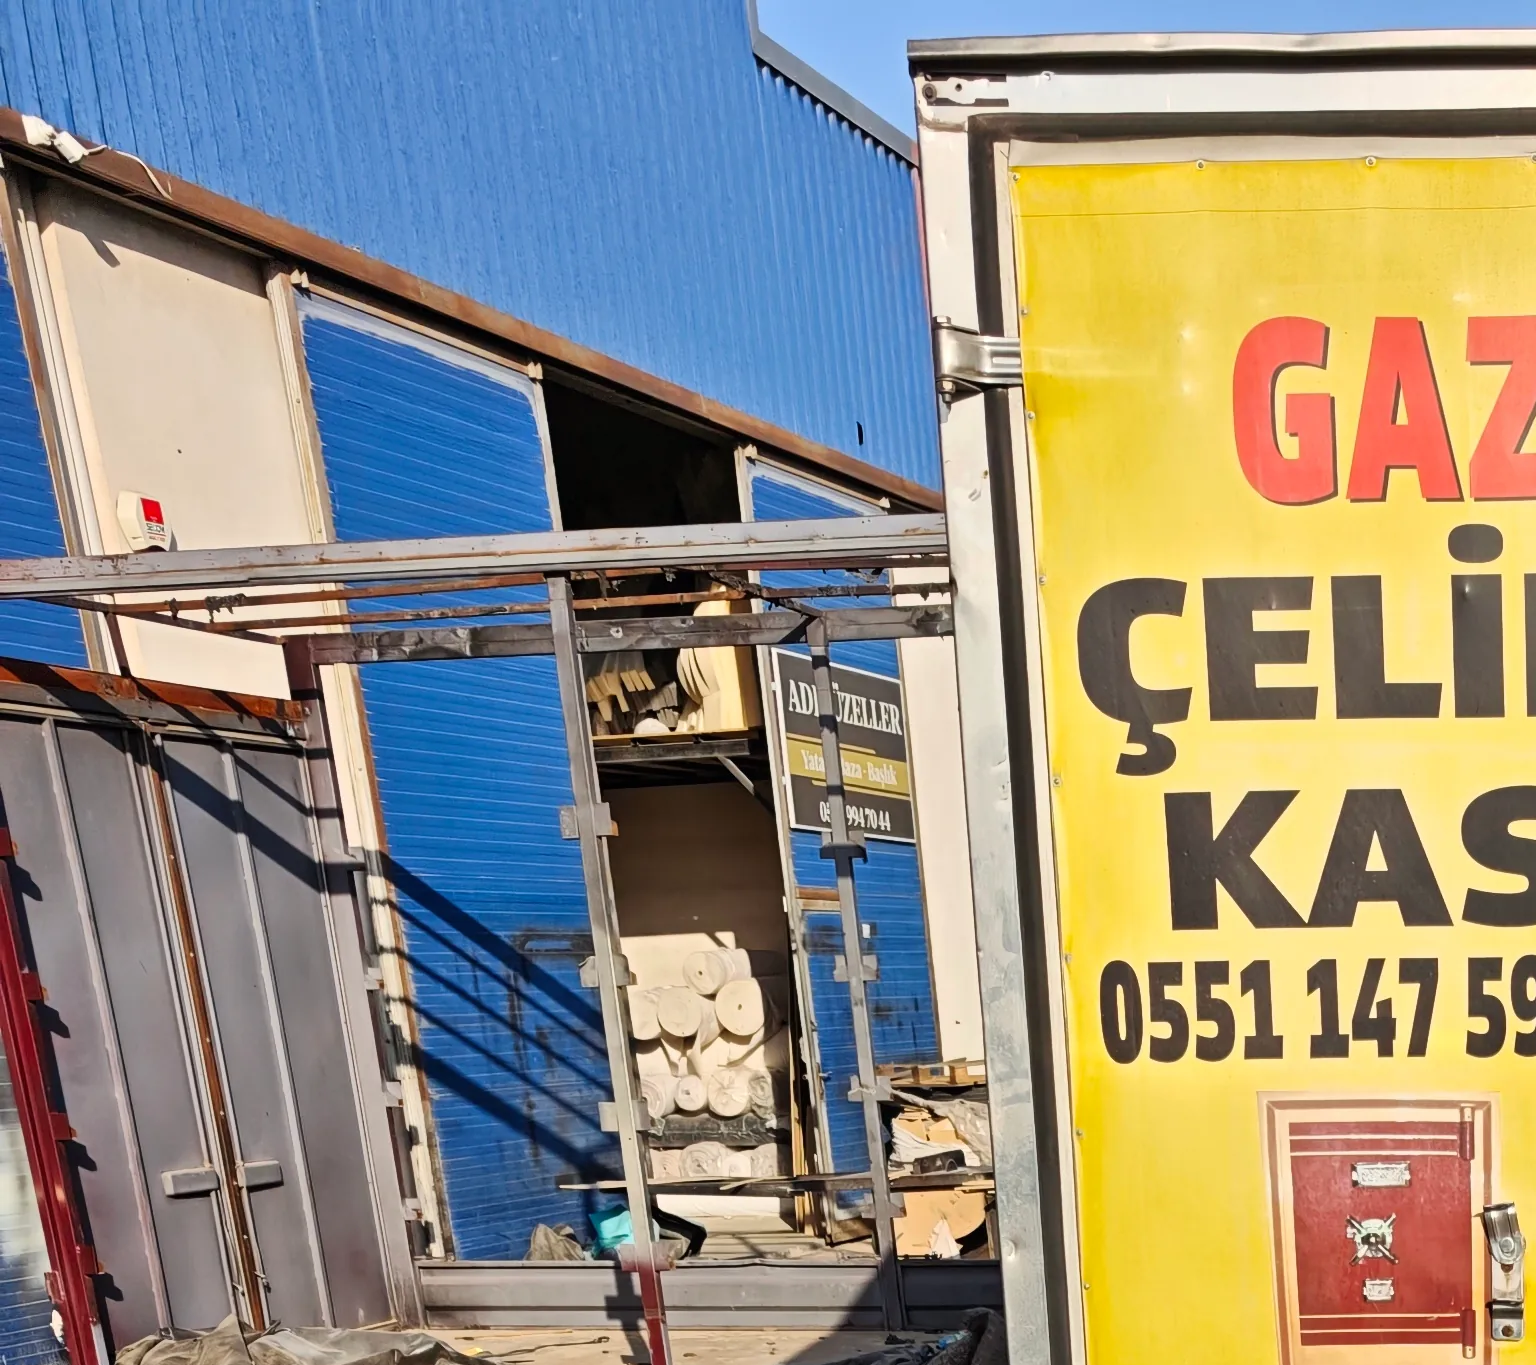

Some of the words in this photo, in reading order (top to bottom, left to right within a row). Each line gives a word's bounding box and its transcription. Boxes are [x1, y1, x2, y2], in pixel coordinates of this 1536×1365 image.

[788, 679, 902, 735] ADIÜZELLER
[800, 749, 828, 773] Yata
[1099, 958, 1283, 1064] 0551
[1307, 957, 1439, 1059] 147
